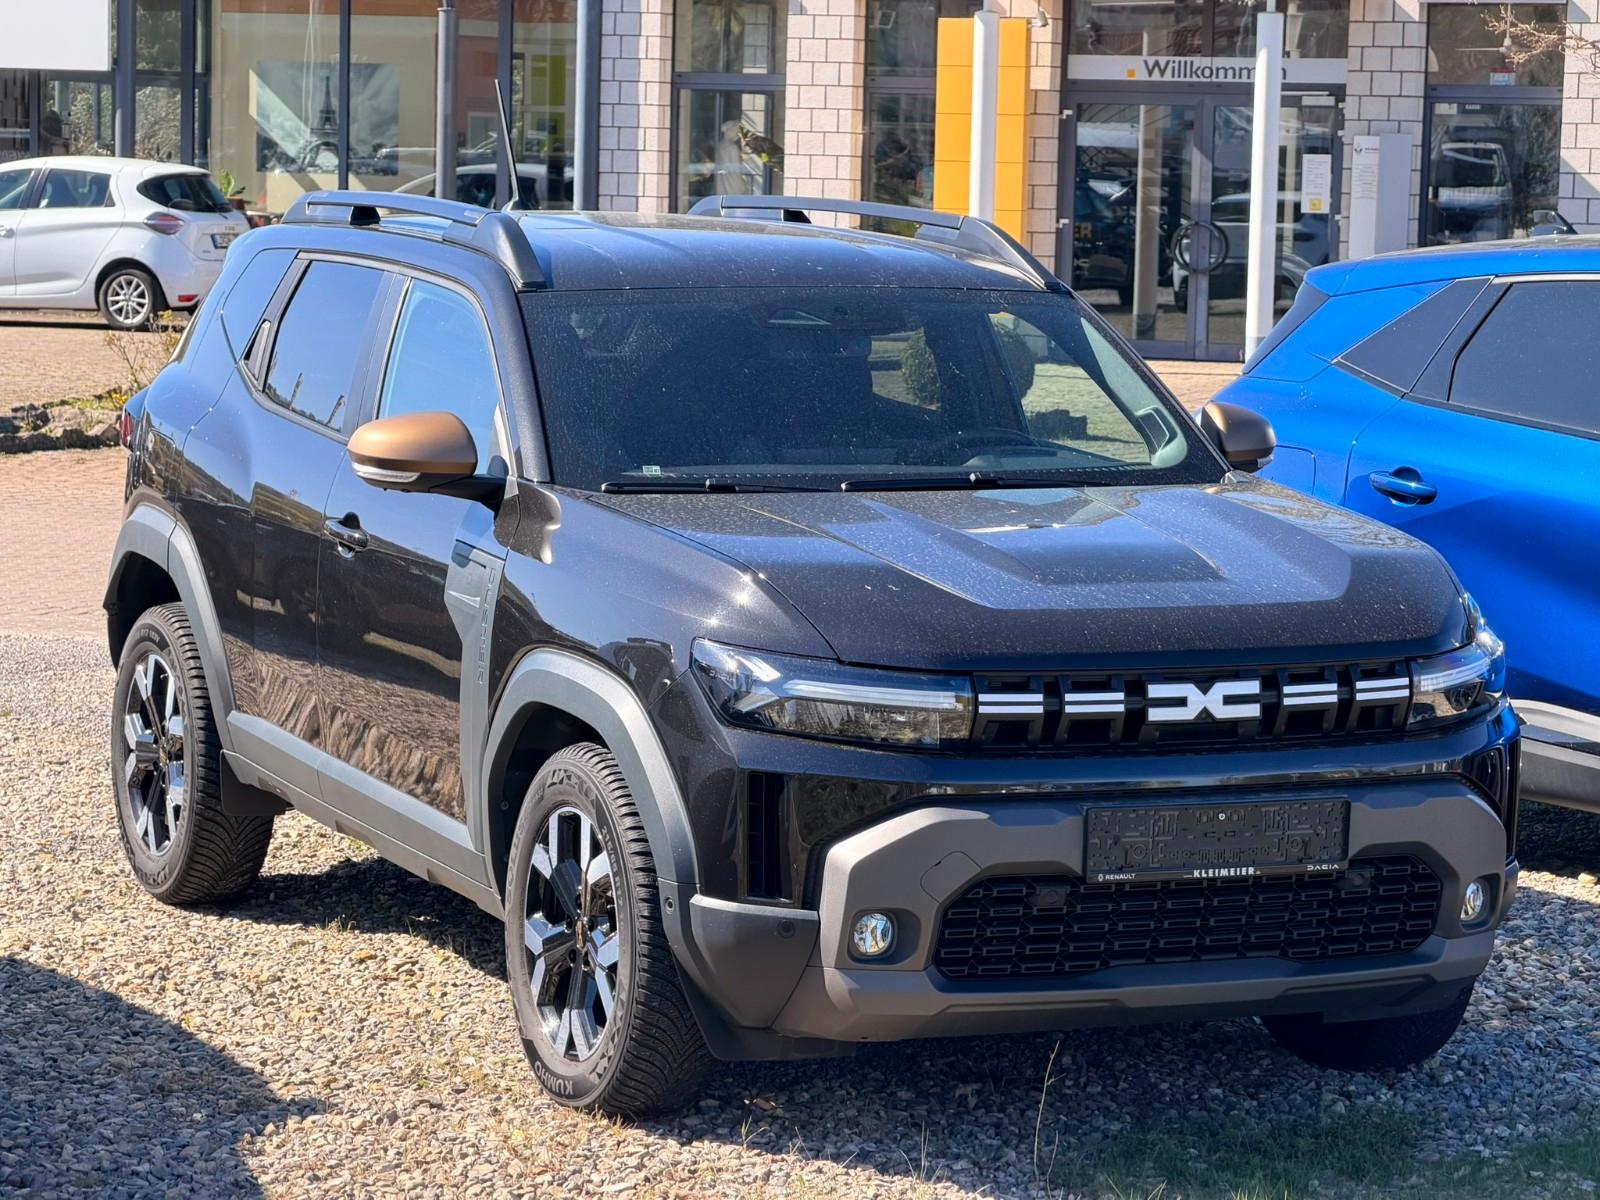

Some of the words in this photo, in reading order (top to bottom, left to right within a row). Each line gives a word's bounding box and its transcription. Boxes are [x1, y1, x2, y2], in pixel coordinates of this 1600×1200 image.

[1143, 59, 1287, 80] Willkommn
[1193, 866, 1255, 878] KLEIMEIER
[534, 1060, 573, 1095] KUMHO
